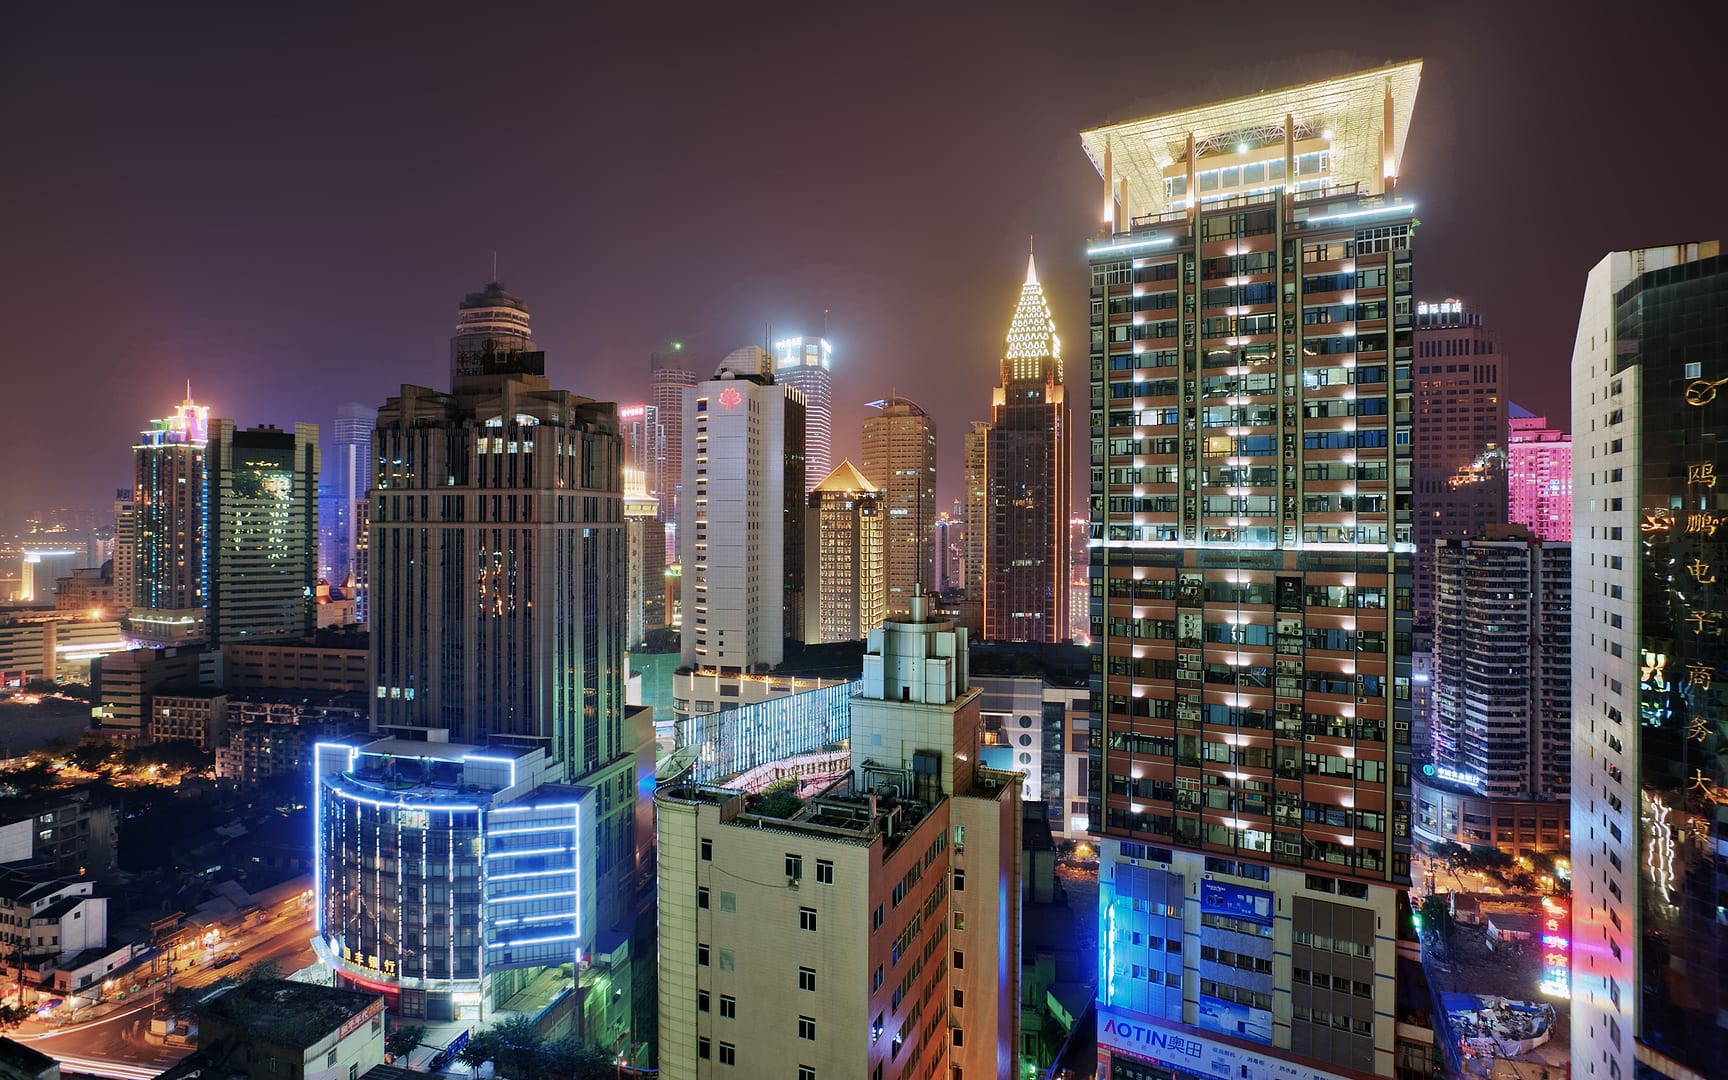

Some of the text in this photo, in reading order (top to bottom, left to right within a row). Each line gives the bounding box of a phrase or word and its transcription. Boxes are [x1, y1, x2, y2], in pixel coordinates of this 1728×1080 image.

[1417, 302, 1462, 315] 国际酒店
[1104, 1019, 1168, 1049] AOTIN
[1167, 1036, 1202, 1059] 奥田
